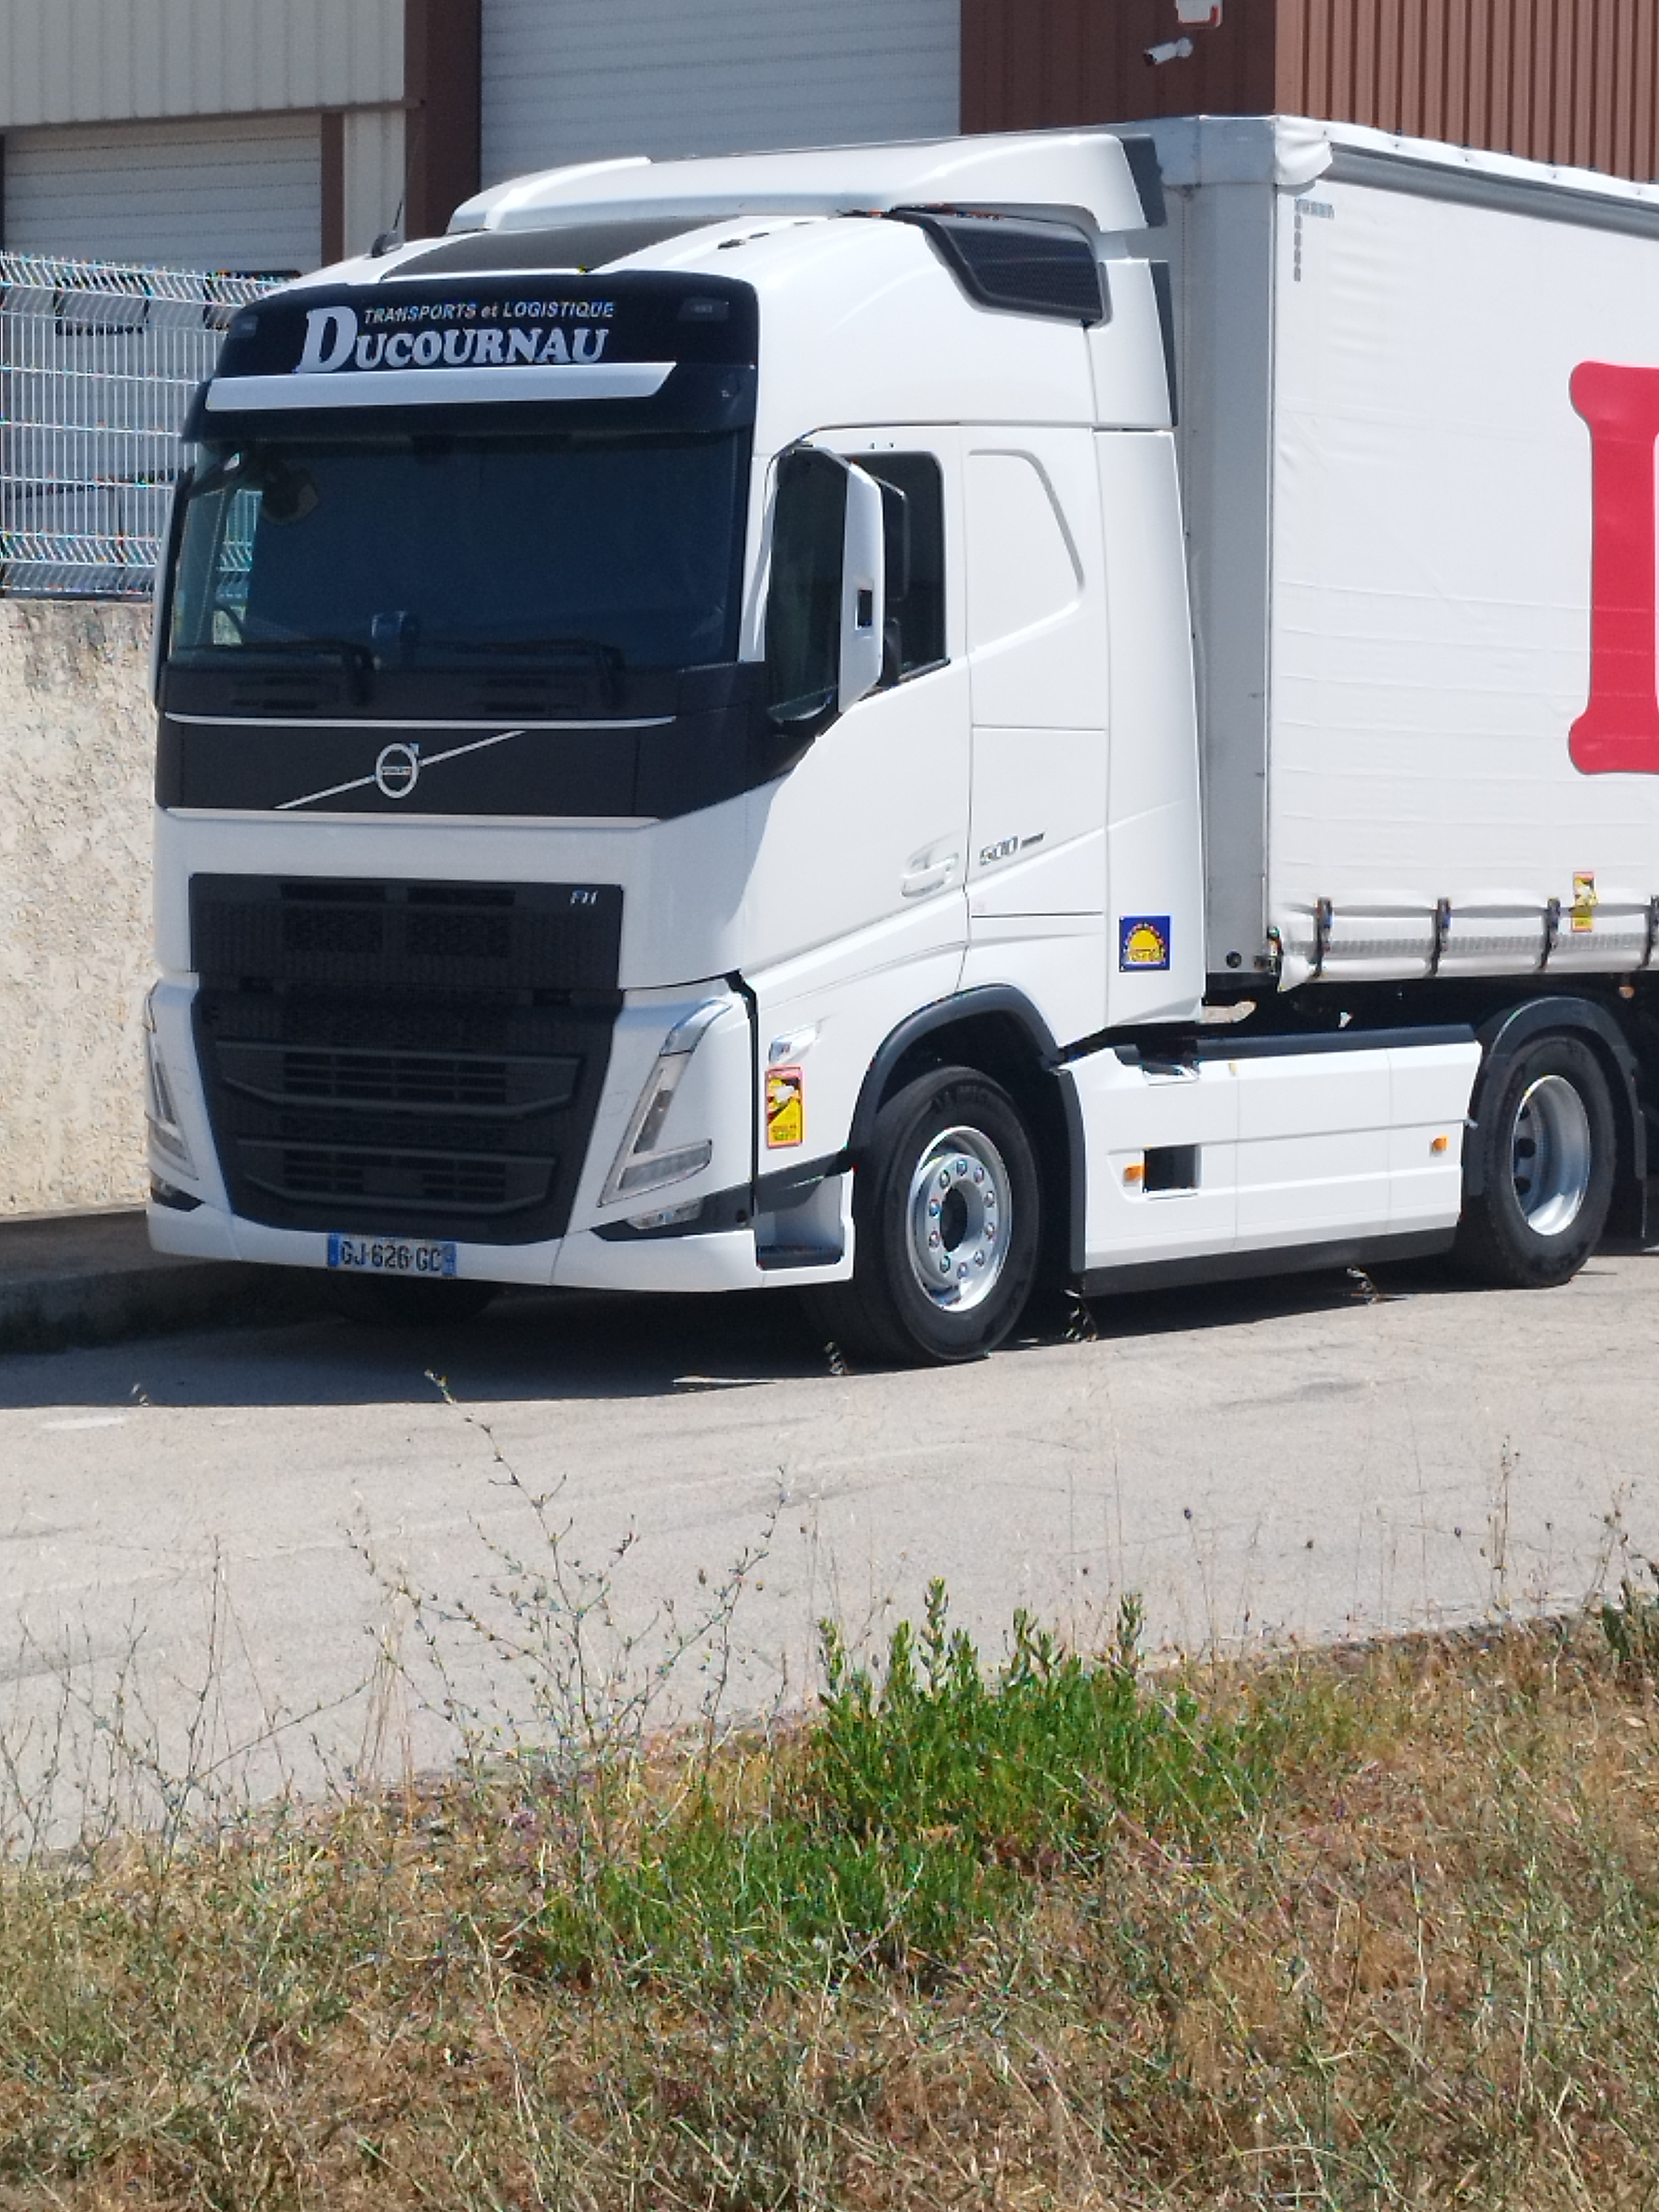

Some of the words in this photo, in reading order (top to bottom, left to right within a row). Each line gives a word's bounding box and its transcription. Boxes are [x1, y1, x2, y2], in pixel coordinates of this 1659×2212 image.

[365, 304, 476, 324] TRANSPORTS
[481, 305, 497, 318] et
[503, 302, 614, 318] LOGISTIQUE
[293, 306, 609, 373] DUCOURNAU
